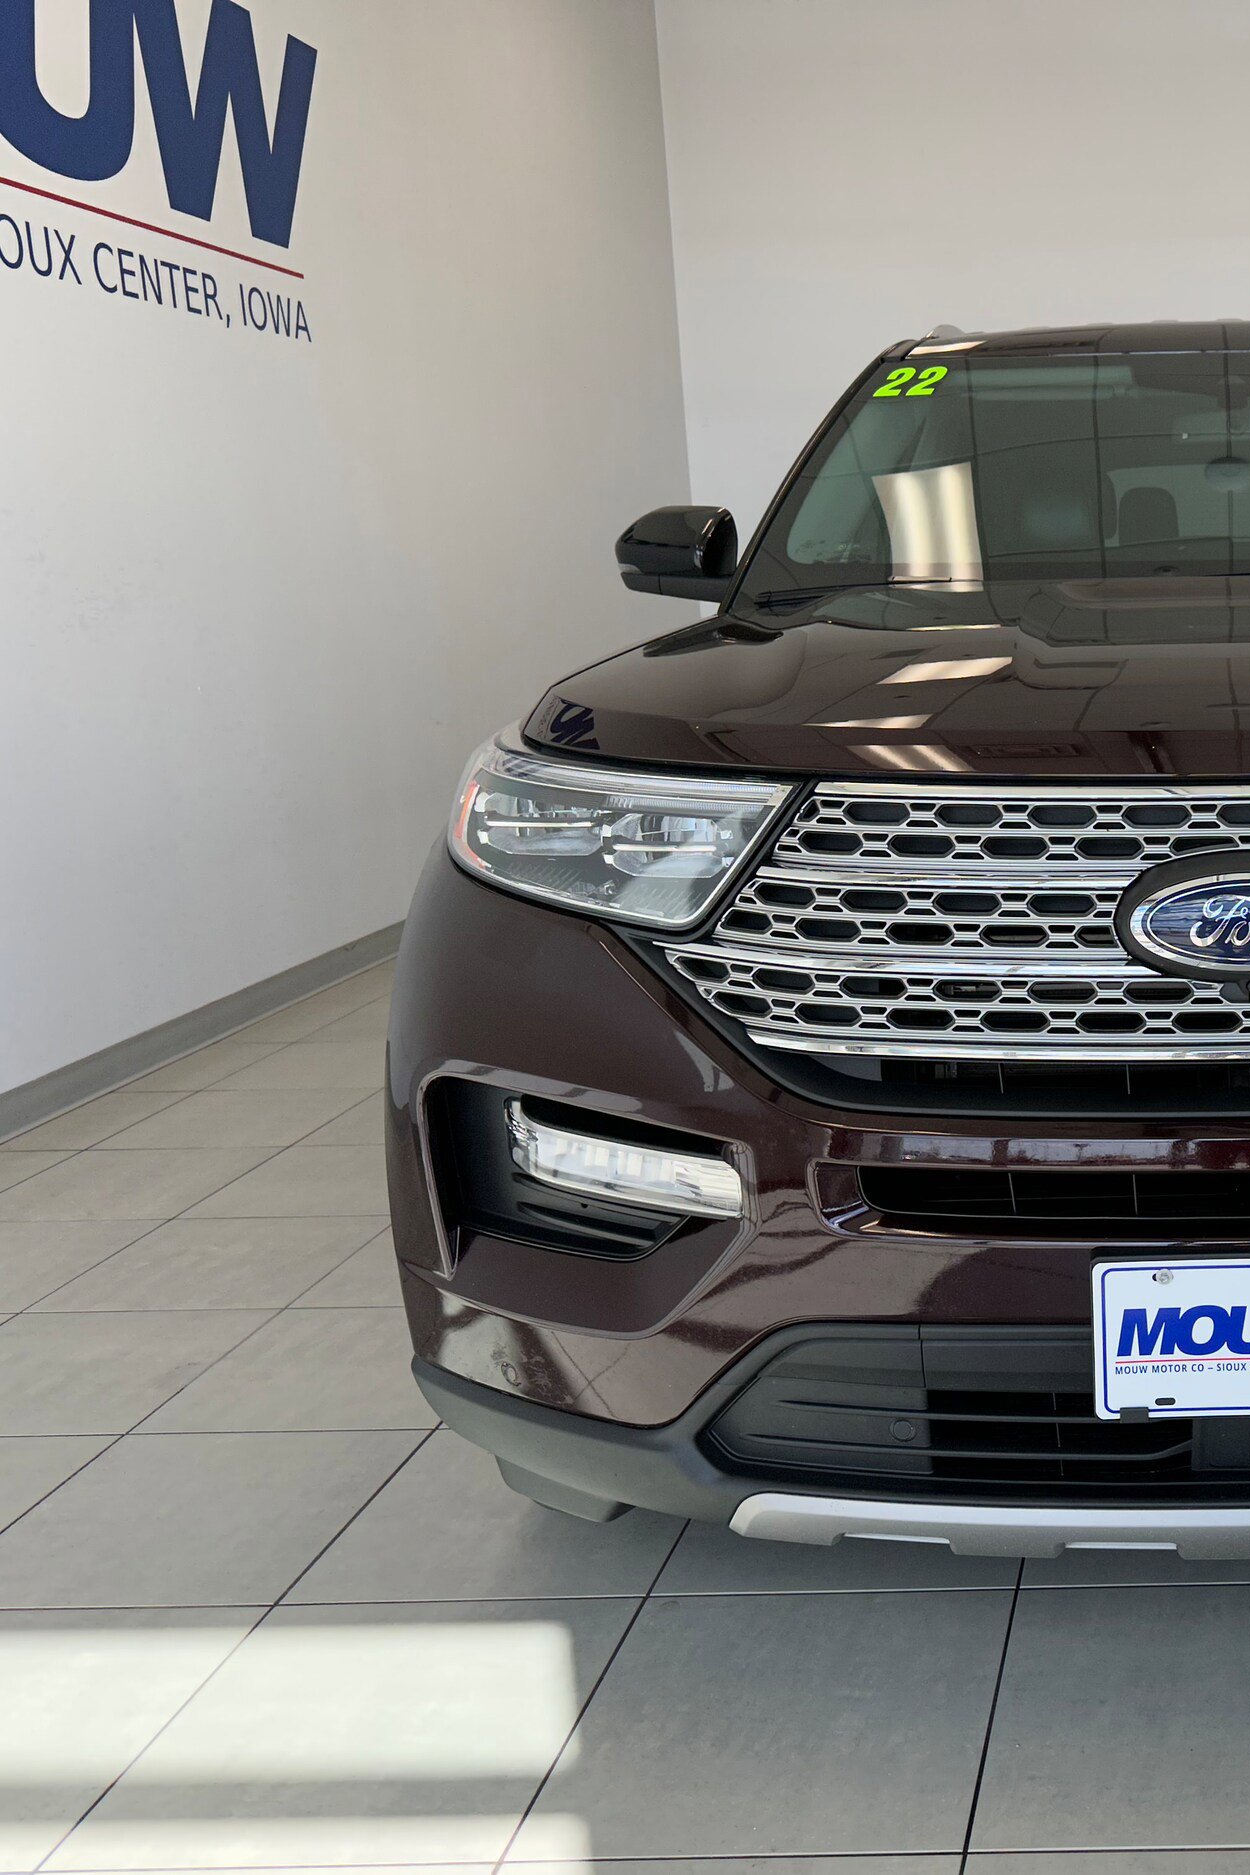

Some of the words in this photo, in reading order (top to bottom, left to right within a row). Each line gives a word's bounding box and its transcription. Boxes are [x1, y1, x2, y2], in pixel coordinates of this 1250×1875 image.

[93, 242, 232, 328] CENTER,
[239, 283, 312, 342] IOWA
[872, 366, 948, 397] 22
[1115, 1365, 1148, 1375] MOUW
[1151, 1364, 1188, 1374] MOTOR
[1191, 1363, 1205, 1372] CO
[1216, 1362, 1247, 1372] SIOUX
